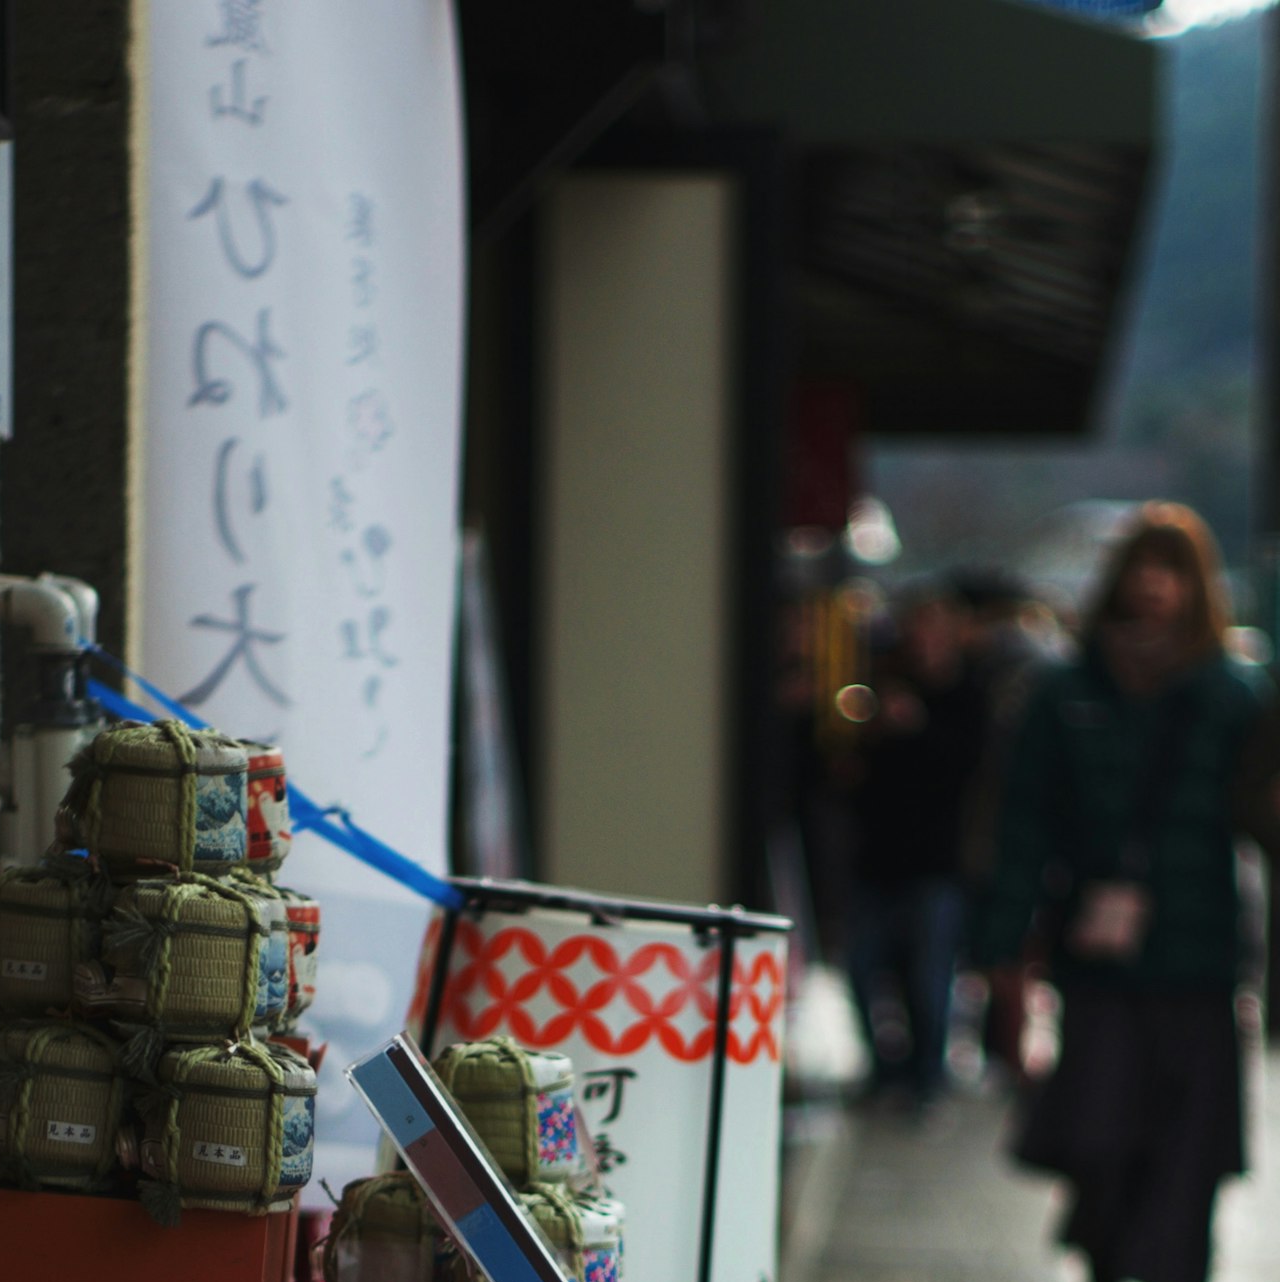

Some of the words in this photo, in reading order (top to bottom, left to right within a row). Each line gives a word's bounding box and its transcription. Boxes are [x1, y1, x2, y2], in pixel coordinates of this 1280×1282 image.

[6, 961, 42, 976] 見本品
[47, 1122, 91, 1139] 見本品
[197, 1144, 242, 1161] 見本品
